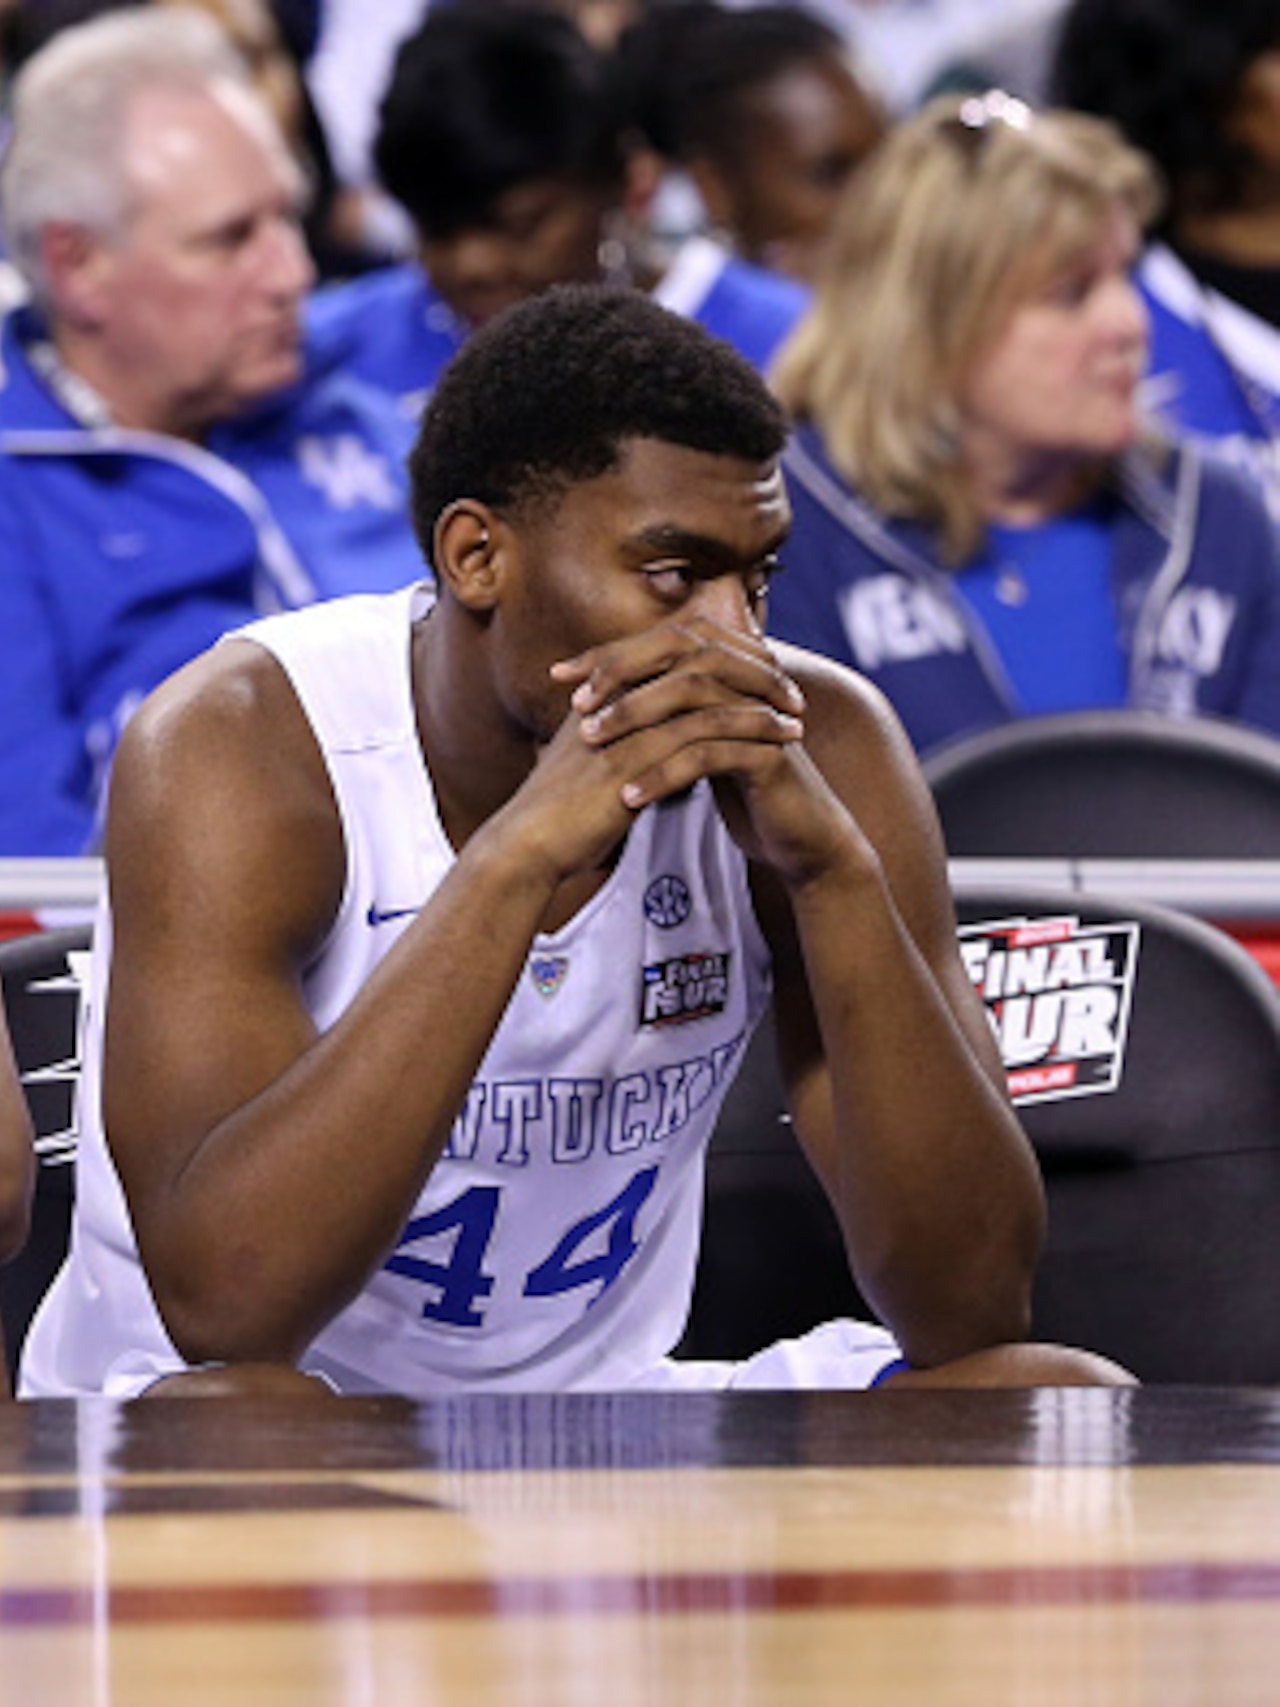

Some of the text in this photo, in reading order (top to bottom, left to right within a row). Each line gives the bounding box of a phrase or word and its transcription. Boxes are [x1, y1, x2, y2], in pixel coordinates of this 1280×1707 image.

[643, 975, 728, 1020] FOUR
[959, 938, 1115, 1000] FINAL
[986, 985, 1119, 1066] UR
[383, 1165, 660, 1327] 44
